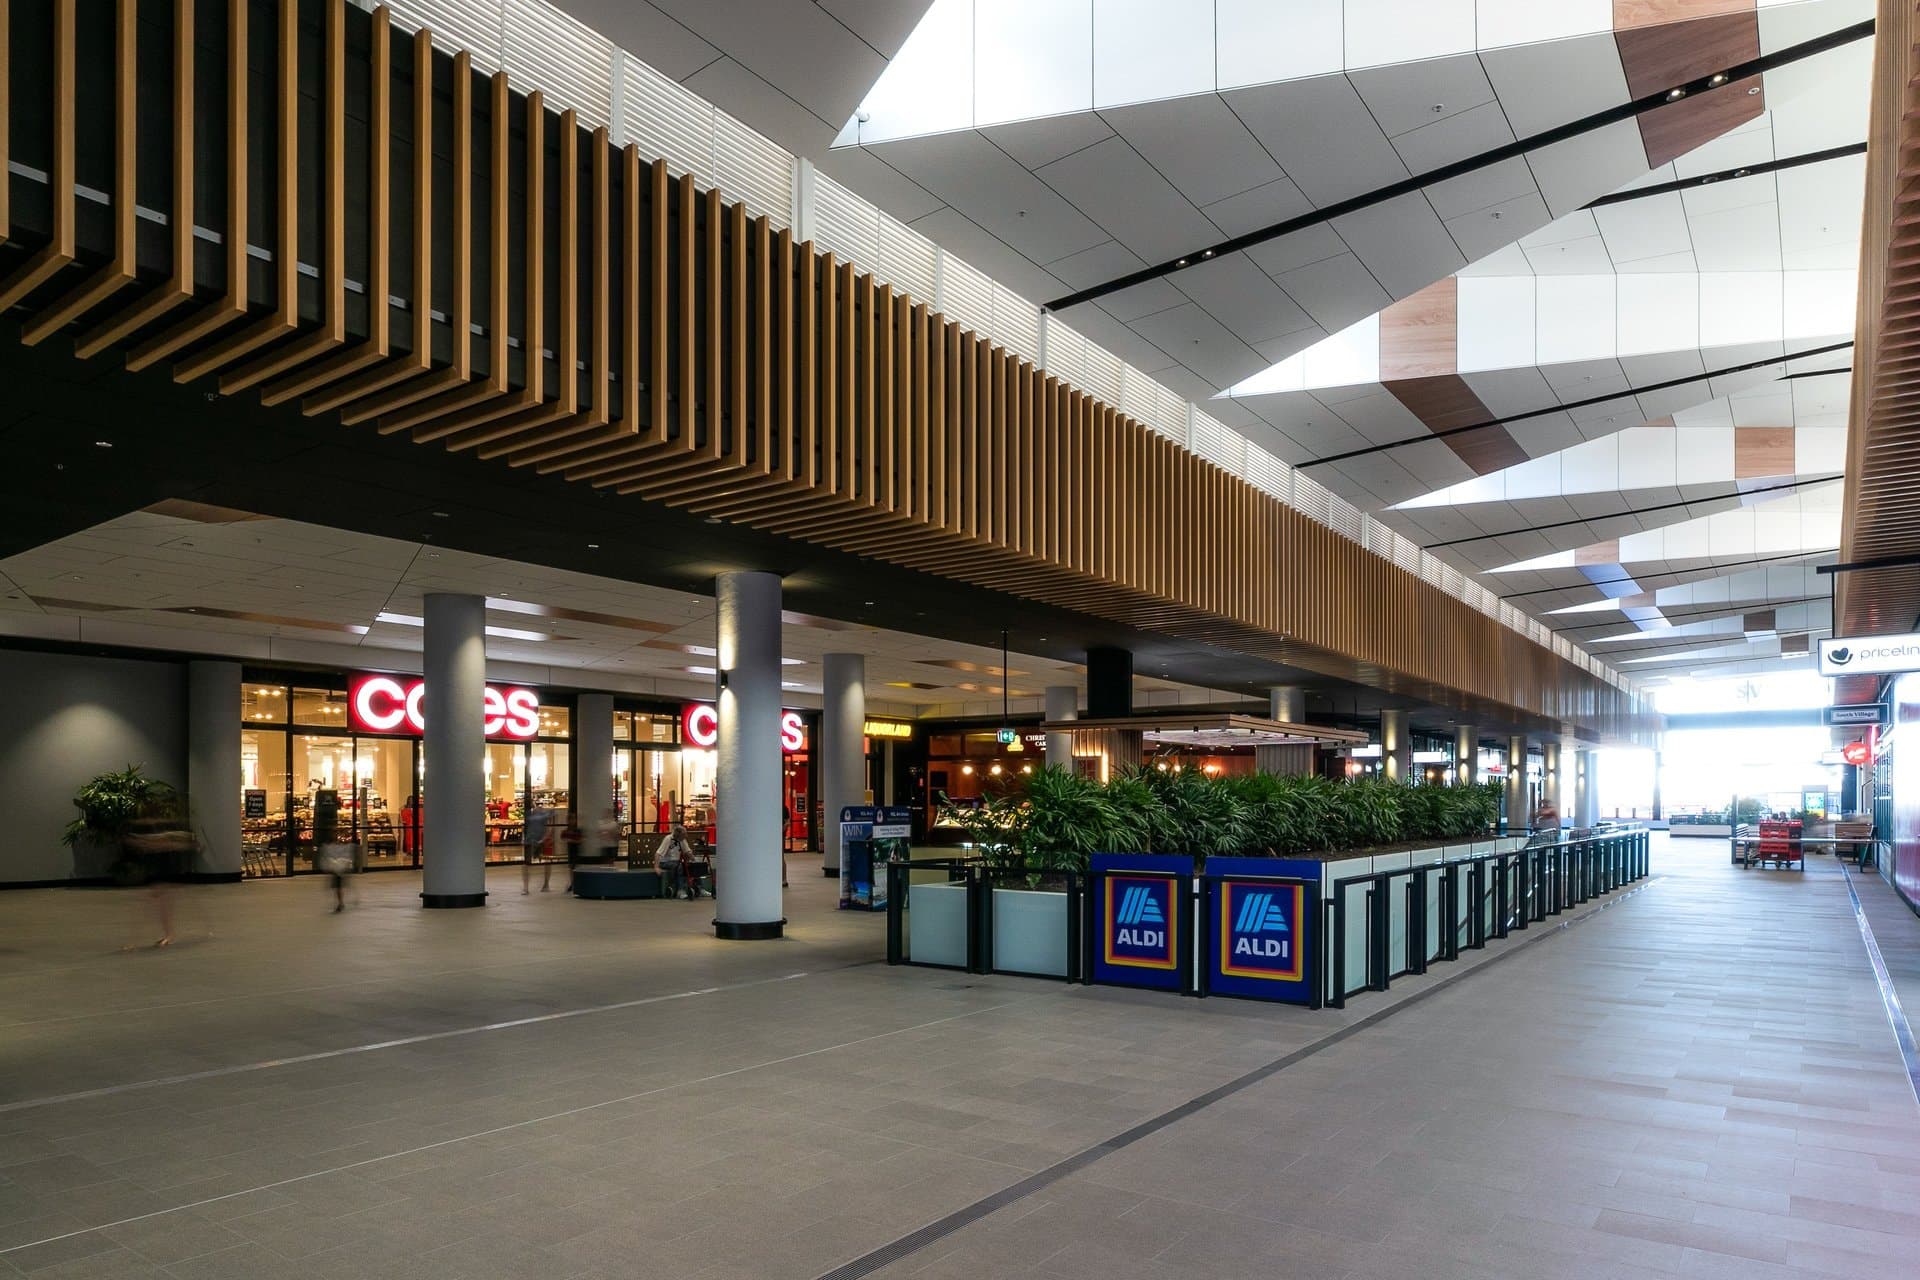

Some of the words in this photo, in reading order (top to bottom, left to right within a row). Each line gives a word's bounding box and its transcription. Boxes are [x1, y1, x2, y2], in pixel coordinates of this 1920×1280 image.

[357, 678, 540, 736] ces
[1117, 929, 1164, 947] ALDI
[1234, 937, 1288, 958] ALDI
